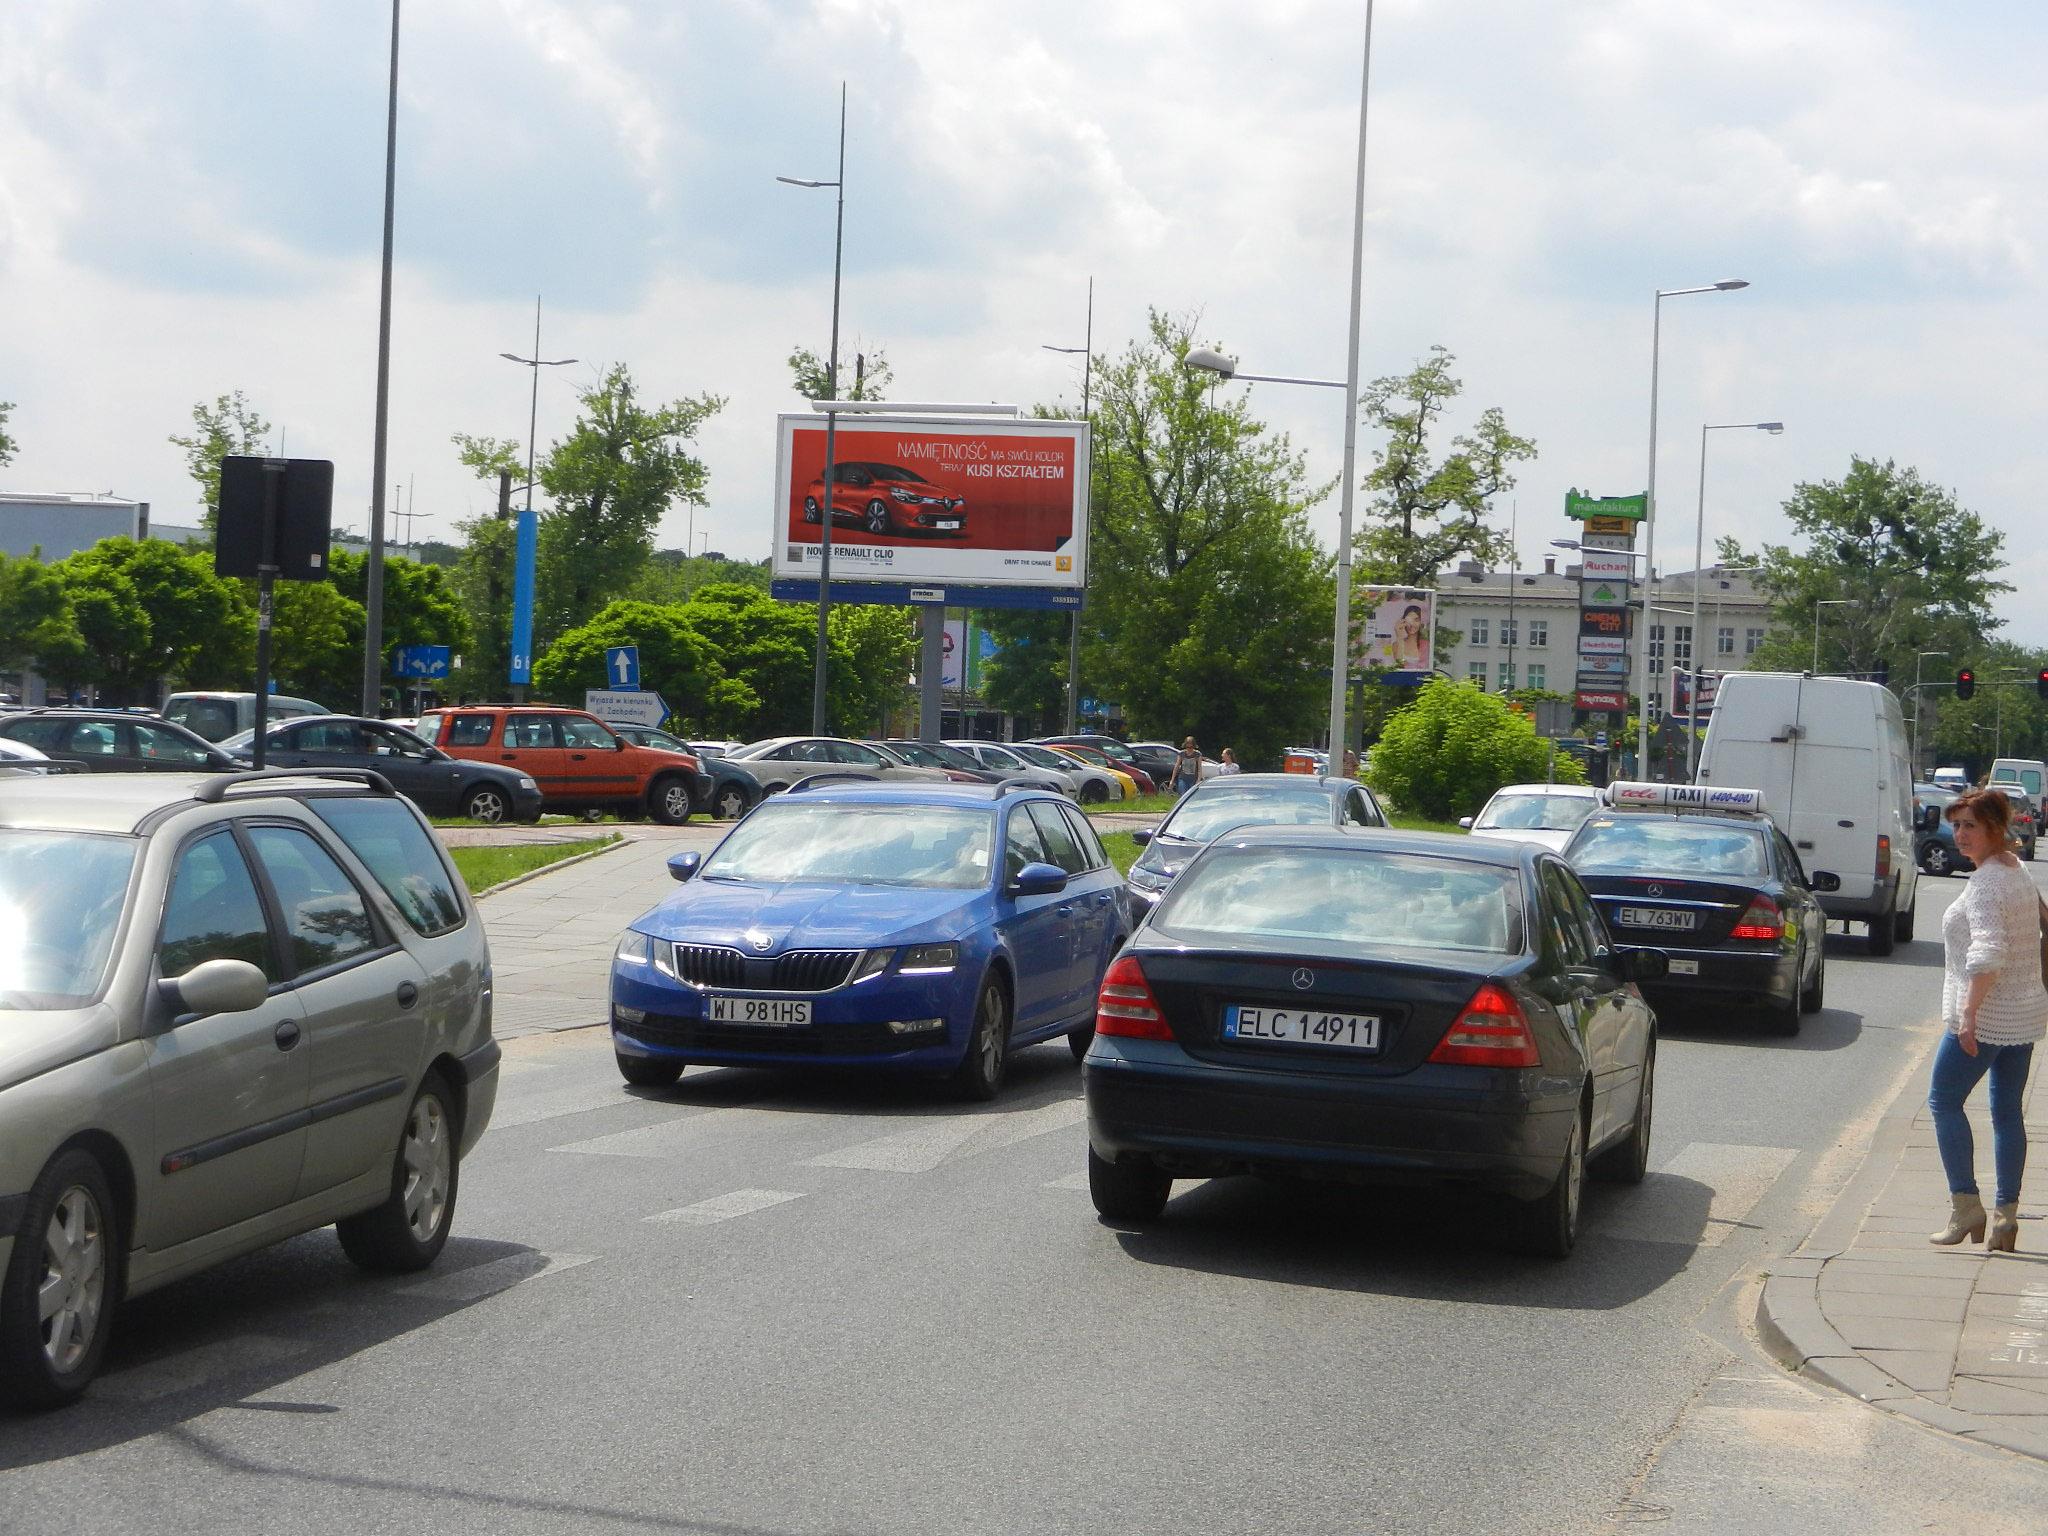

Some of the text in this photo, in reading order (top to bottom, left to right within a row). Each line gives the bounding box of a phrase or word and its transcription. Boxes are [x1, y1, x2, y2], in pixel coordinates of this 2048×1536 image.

[897, 441, 1064, 462] NAMIĘTNOŚĆ MA SWÓJ KOLOR
[966, 464, 993, 477] KUSI
[996, 465, 1064, 478] KSZTAŁTEM
[1574, 501, 1639, 513] manufaktura
[806, 546, 832, 556] NOE
[834, 547, 872, 557] RENAULT
[874, 549, 894, 558] CLIO
[1584, 560, 1627, 571] Auchan
[1671, 787, 1700, 801] TAXI
[1622, 909, 1692, 926] EL 763WV
[714, 1000, 806, 1022] WI 981HS
[1238, 1009, 1373, 1045] ELC 14911
